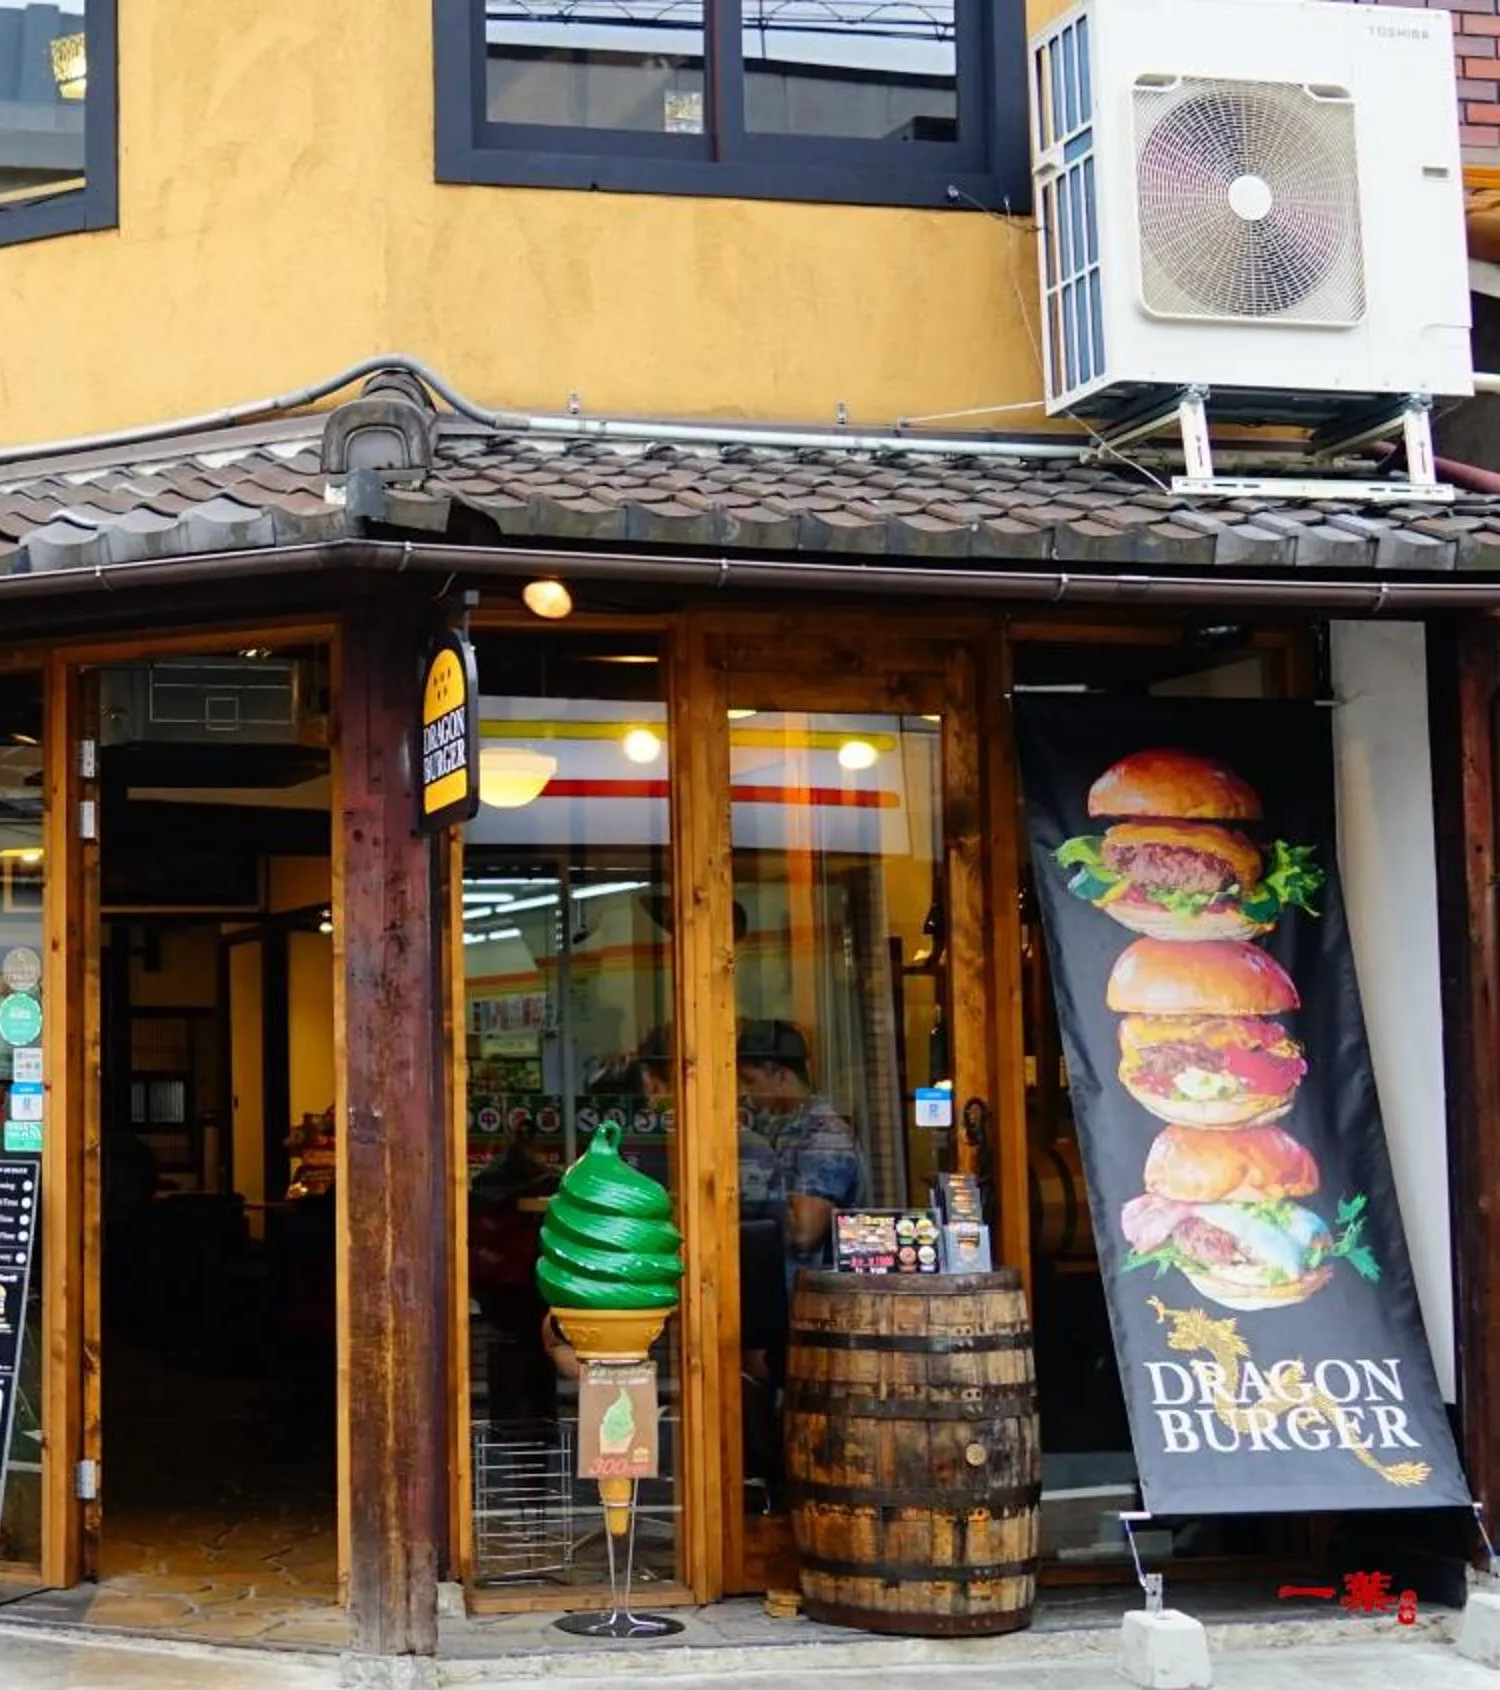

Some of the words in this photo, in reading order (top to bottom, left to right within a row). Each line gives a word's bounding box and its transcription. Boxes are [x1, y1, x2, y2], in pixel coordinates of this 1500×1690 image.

[1367, 25, 1430, 40] TOSHIBA
[423, 705, 466, 756] DRAGON
[423, 736, 467, 784] BURGER
[1143, 1358, 1405, 1405] DRAGON
[1155, 1404, 1422, 1453] BURGER
